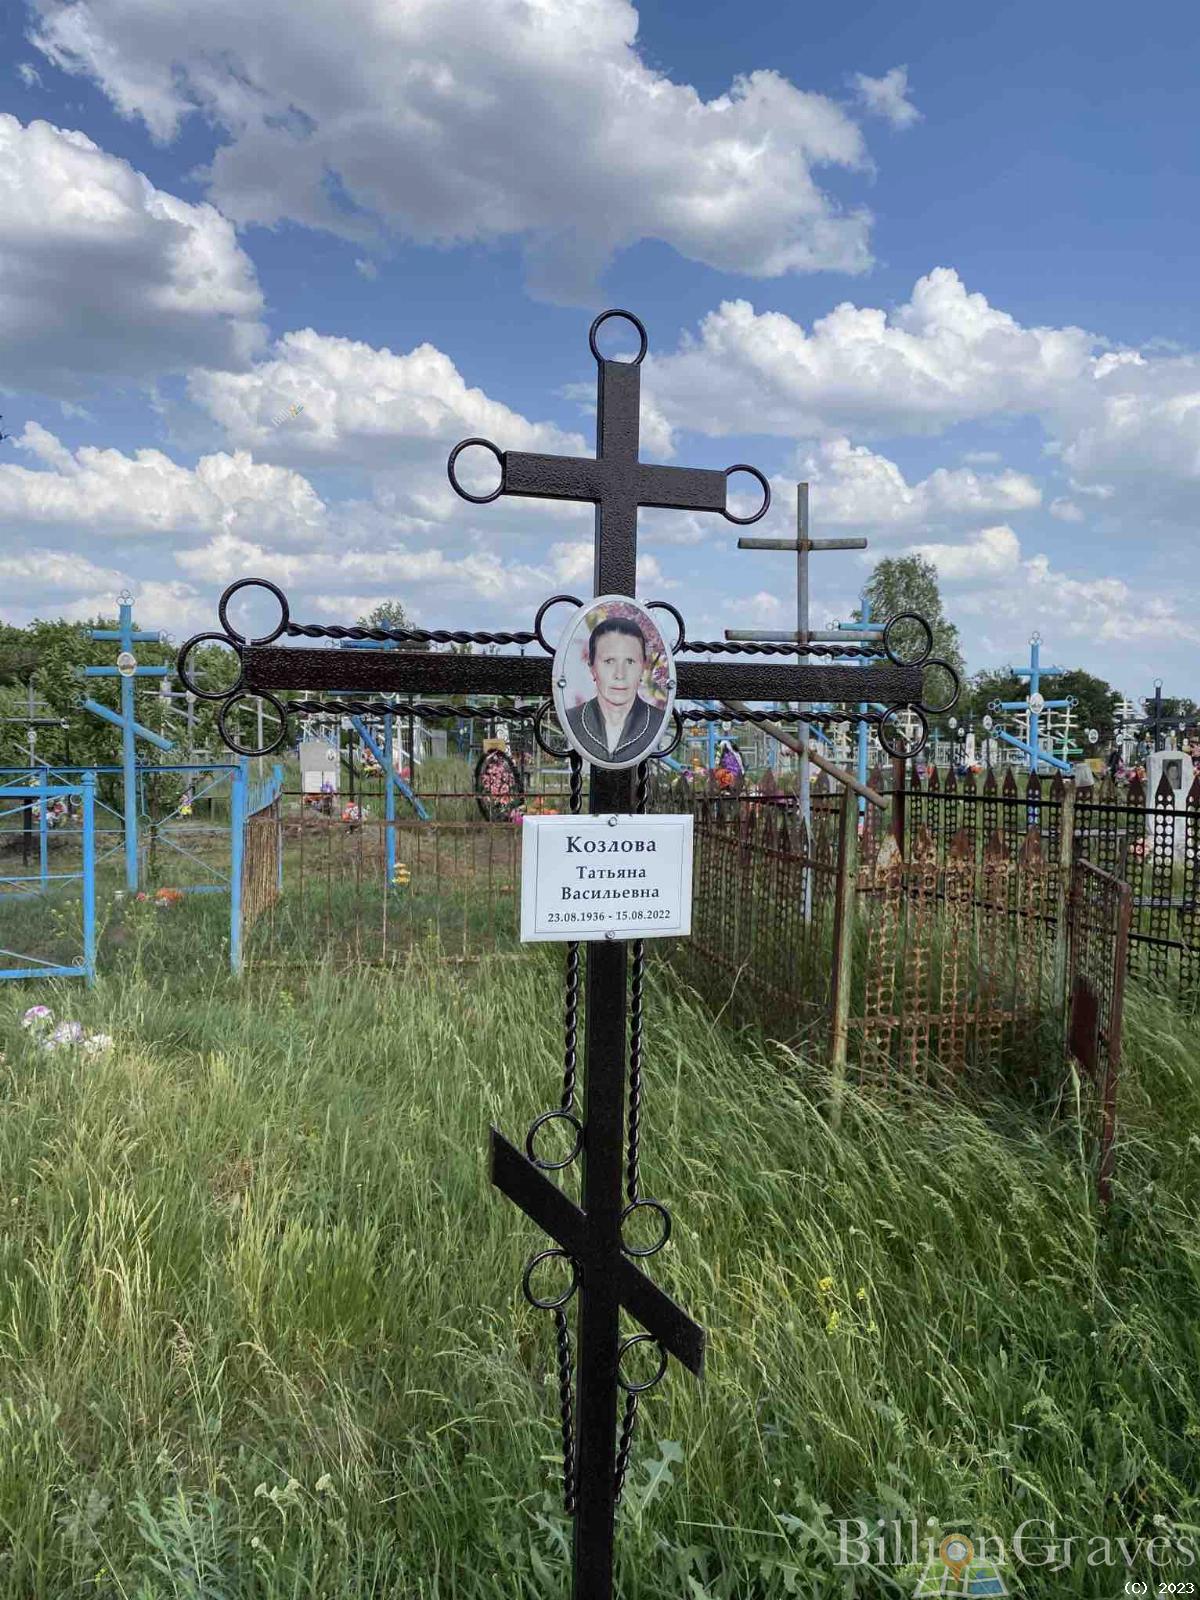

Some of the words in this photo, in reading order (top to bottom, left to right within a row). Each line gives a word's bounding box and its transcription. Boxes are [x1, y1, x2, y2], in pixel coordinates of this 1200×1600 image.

[566, 836, 657, 853] Козлова
[576, 866, 646, 879] Татьяна
[561, 887, 660, 900] Васильевна
[547, 911, 605, 923] 23.08.1936
[616, 909, 671, 921] 15.08.2022
